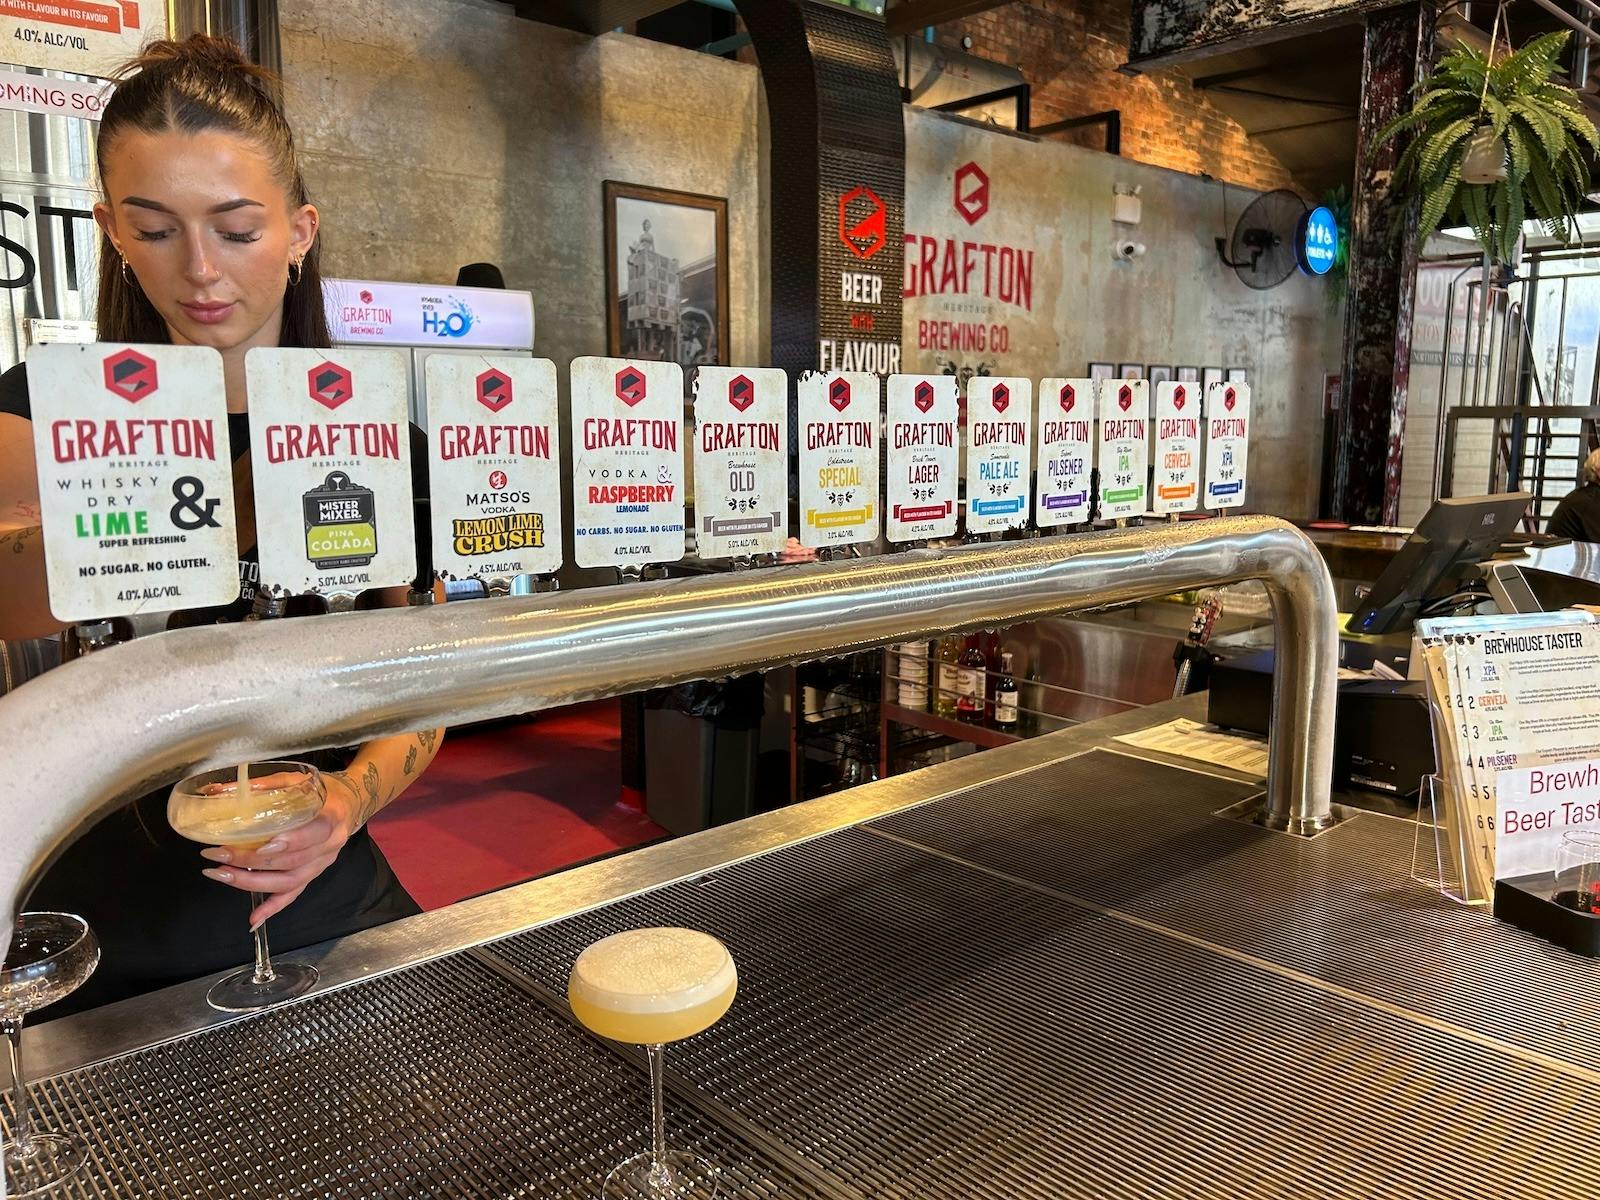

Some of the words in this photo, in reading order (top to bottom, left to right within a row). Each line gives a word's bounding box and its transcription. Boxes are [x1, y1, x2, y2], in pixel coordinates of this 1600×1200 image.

[8, 0, 26, 10] WITH
[27, 2, 60, 17] FLAVOUR
[61, 8, 69, 17] IN
[70, 9, 81, 20] ITS
[82, 10, 109, 25] FAVOUR
[14, 27, 42, 44] 4.0%
[44, 33, 89, 51] ALC/VOL
[902, 233, 1034, 312] GRAFTON
[841, 272, 882, 305] BEER
[342, 306, 392, 324] GRAFTON
[350, 326, 375, 336] BREWING
[919, 320, 986, 352] BREWING
[820, 340, 901, 375] FLAVOUR
[584, 418, 677, 453] GRAFTON
[703, 423, 779, 453] GRAFTON
[807, 422, 872, 451] GRAFTON
[895, 422, 953, 450] GRAFTON
[974, 422, 1026, 447] GRAFTON
[1044, 420, 1089, 445] GRAFTON
[1104, 419, 1144, 442] GRAFTON
[1160, 418, 1197, 440] GRAFTON
[1212, 418, 1246, 439] GRAFTON
[51, 418, 216, 464] GRAFTON
[265, 423, 400, 464] GRAFTON
[440, 425, 550, 461] GRAFTON
[109, 460, 168, 468] HERITAGE
[1048, 458, 1083, 477] PILSENER
[1118, 455, 1129, 471] IPA
[1164, 453, 1191, 469] CERVEZA
[1222, 451, 1233, 467] XPA
[589, 469, 647, 478] VODKA
[657, 464, 673, 484] &
[818, 466, 861, 488] SPECIAL
[909, 464, 939, 485] LAGER
[980, 462, 1001, 480] PALE
[1003, 461, 1019, 479] ALE
[57, 476, 159, 490] WHISKY
[730, 470, 755, 492] OLD
[87, 496, 134, 507] DRY
[169, 475, 222, 531] &
[466, 490, 531, 506] MATSO'S
[588, 485, 675, 504] RASPBERRY
[319, 500, 359, 511] MISTER
[481, 506, 516, 514] VODKA
[616, 504, 650, 513] LEMONADE
[75, 510, 149, 538] LIME
[453, 517, 506, 538] LEMON
[507, 513, 544, 531] LIME
[576, 528, 587, 536] NO
[588, 527, 612, 536] CARBS.
[625, 525, 649, 534] SUGAR.
[99, 538, 129, 548] SUPER
[132, 534, 187, 547] REFRESHING
[311, 537, 372, 552] COLADA
[453, 529, 545, 556] CRUSH
[628, 545, 653, 554] ALC/VOL
[79, 566, 96, 577] NO
[100, 563, 144, 575] SUGAR.
[147, 561, 163, 571] NO
[167, 557, 211, 569] GLUTEN.
[496, 562, 523, 573] ALC/VOL
[318, 576, 339, 587] 5.0%
[339, 573, 372, 586] ALC/VOL
[117, 589, 141, 602] 4.0%
[143, 585, 182, 600] ALC/VOL
[1484, 636, 1545, 655] BREWHOUSE
[1546, 632, 1584, 650] TASTER
[1465, 665, 1472, 680] 1
[1483, 665, 1497, 677] XPA
[1456, 694, 1464, 709] 2
[1468, 696, 1476, 710] 2
[1478, 695, 1509, 708] CERVEZA
[1472, 725, 1480, 739] 3
[1491, 725, 1504, 736] IPA
[1478, 755, 1485, 770] 4
[1486, 754, 1518, 767] PILSENER
[1483, 786, 1490, 800] 5
[1476, 814, 1484, 829] 6
[1487, 816, 1495, 830] 6
[1504, 809, 1556, 834] Beer
[1481, 845, 1489, 860] 7
